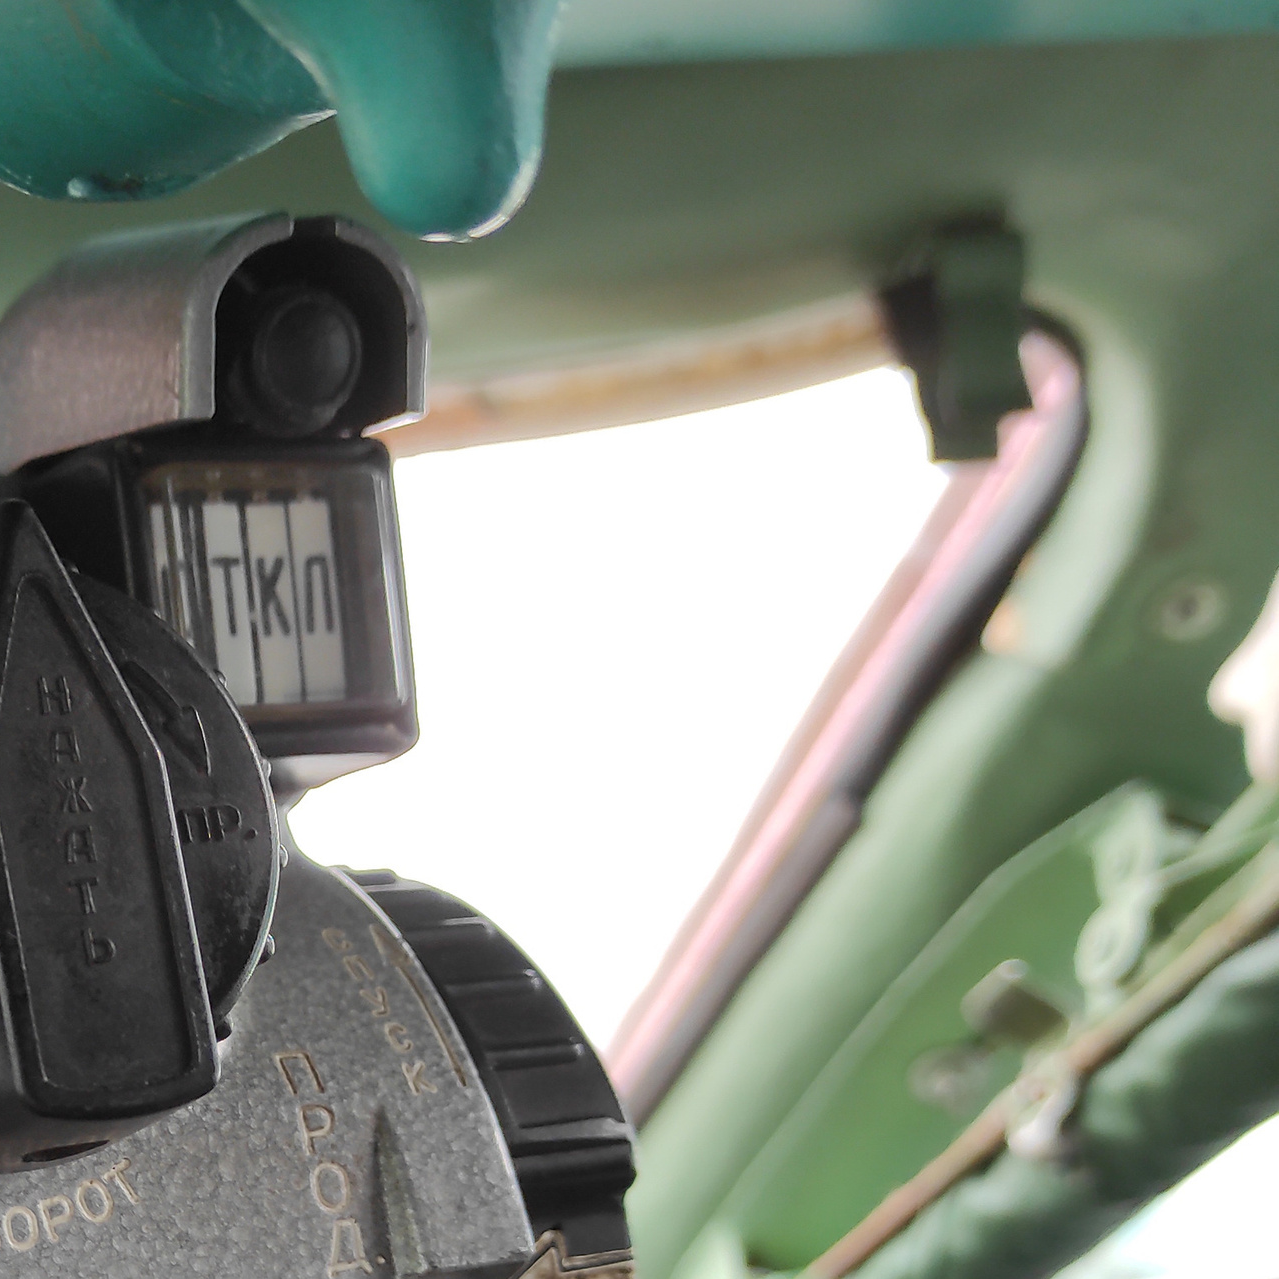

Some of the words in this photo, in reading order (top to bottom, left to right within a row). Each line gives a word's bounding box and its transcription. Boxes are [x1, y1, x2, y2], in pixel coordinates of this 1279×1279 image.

[161, 555, 336, 638] ТКЛ
[38, 674, 117, 966] НАЖАТЬ
[321, 927, 436, 1095] СПУСК
[273, 1050, 386, 1278] ПРОД.
